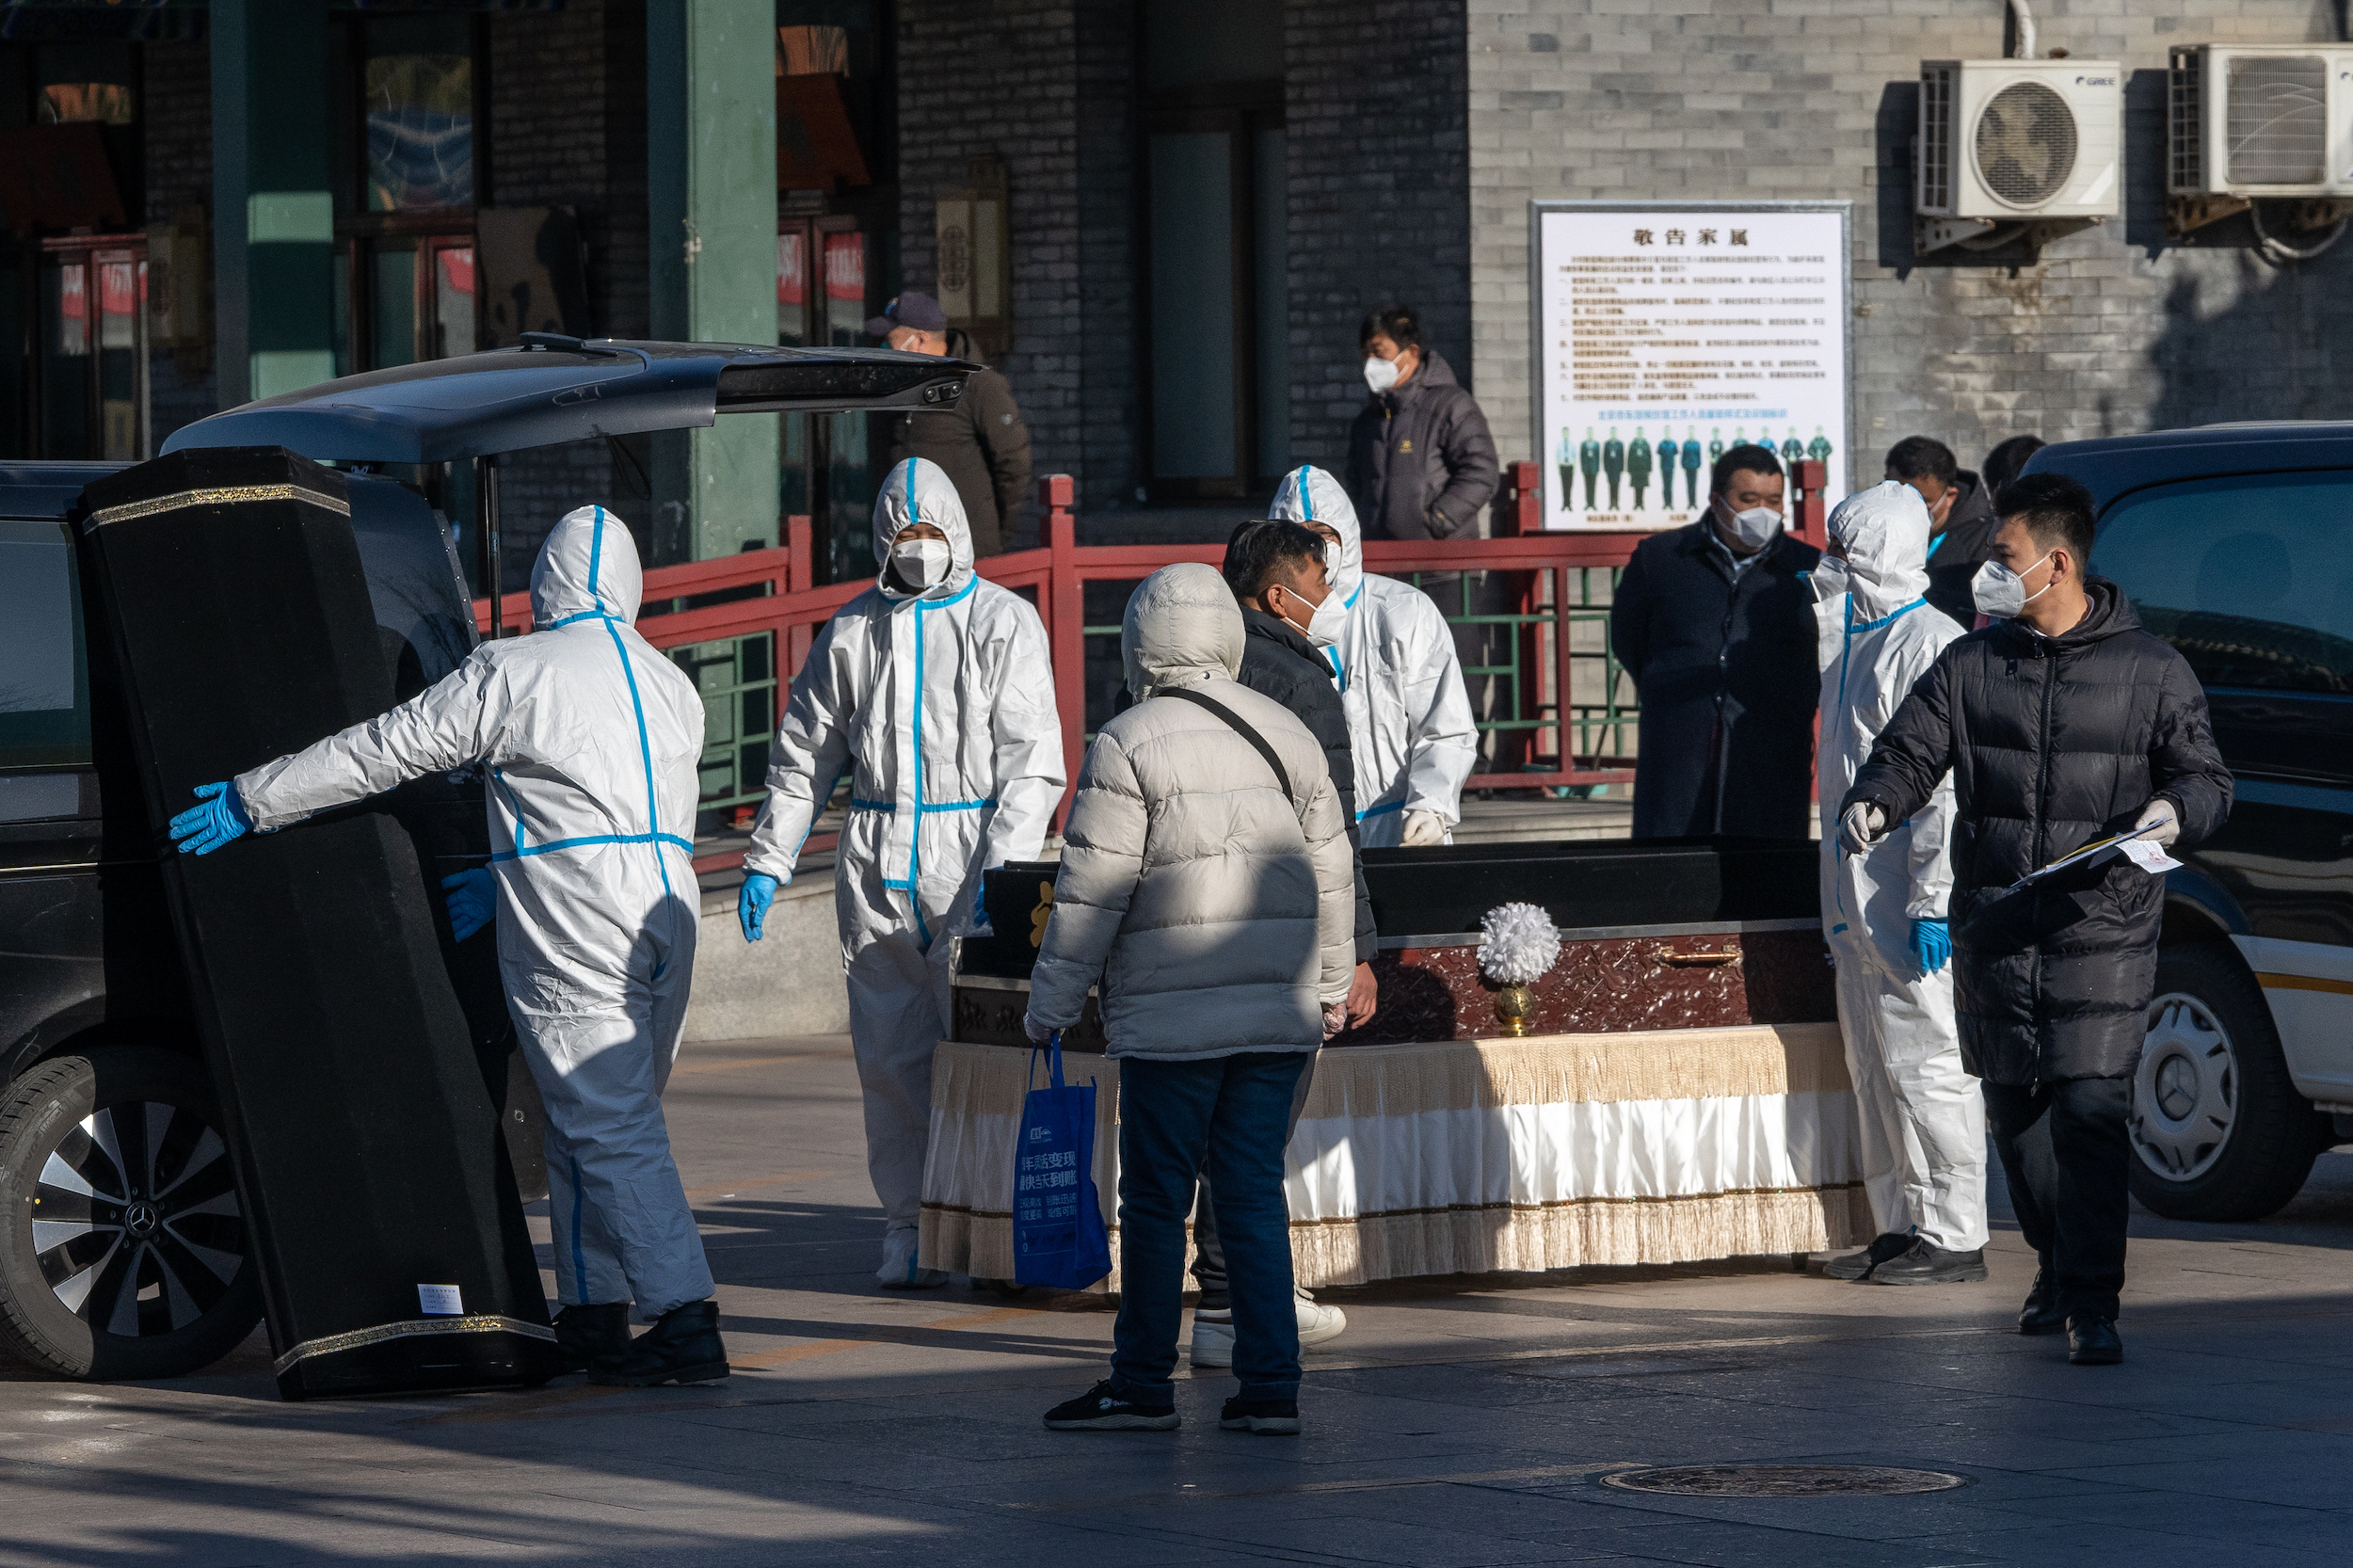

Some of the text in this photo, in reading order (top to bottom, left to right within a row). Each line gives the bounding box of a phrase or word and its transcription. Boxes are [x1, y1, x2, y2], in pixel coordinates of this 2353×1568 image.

[2087, 77, 2116, 86] GREE
[1634, 229, 1749, 246] 敬告家属
